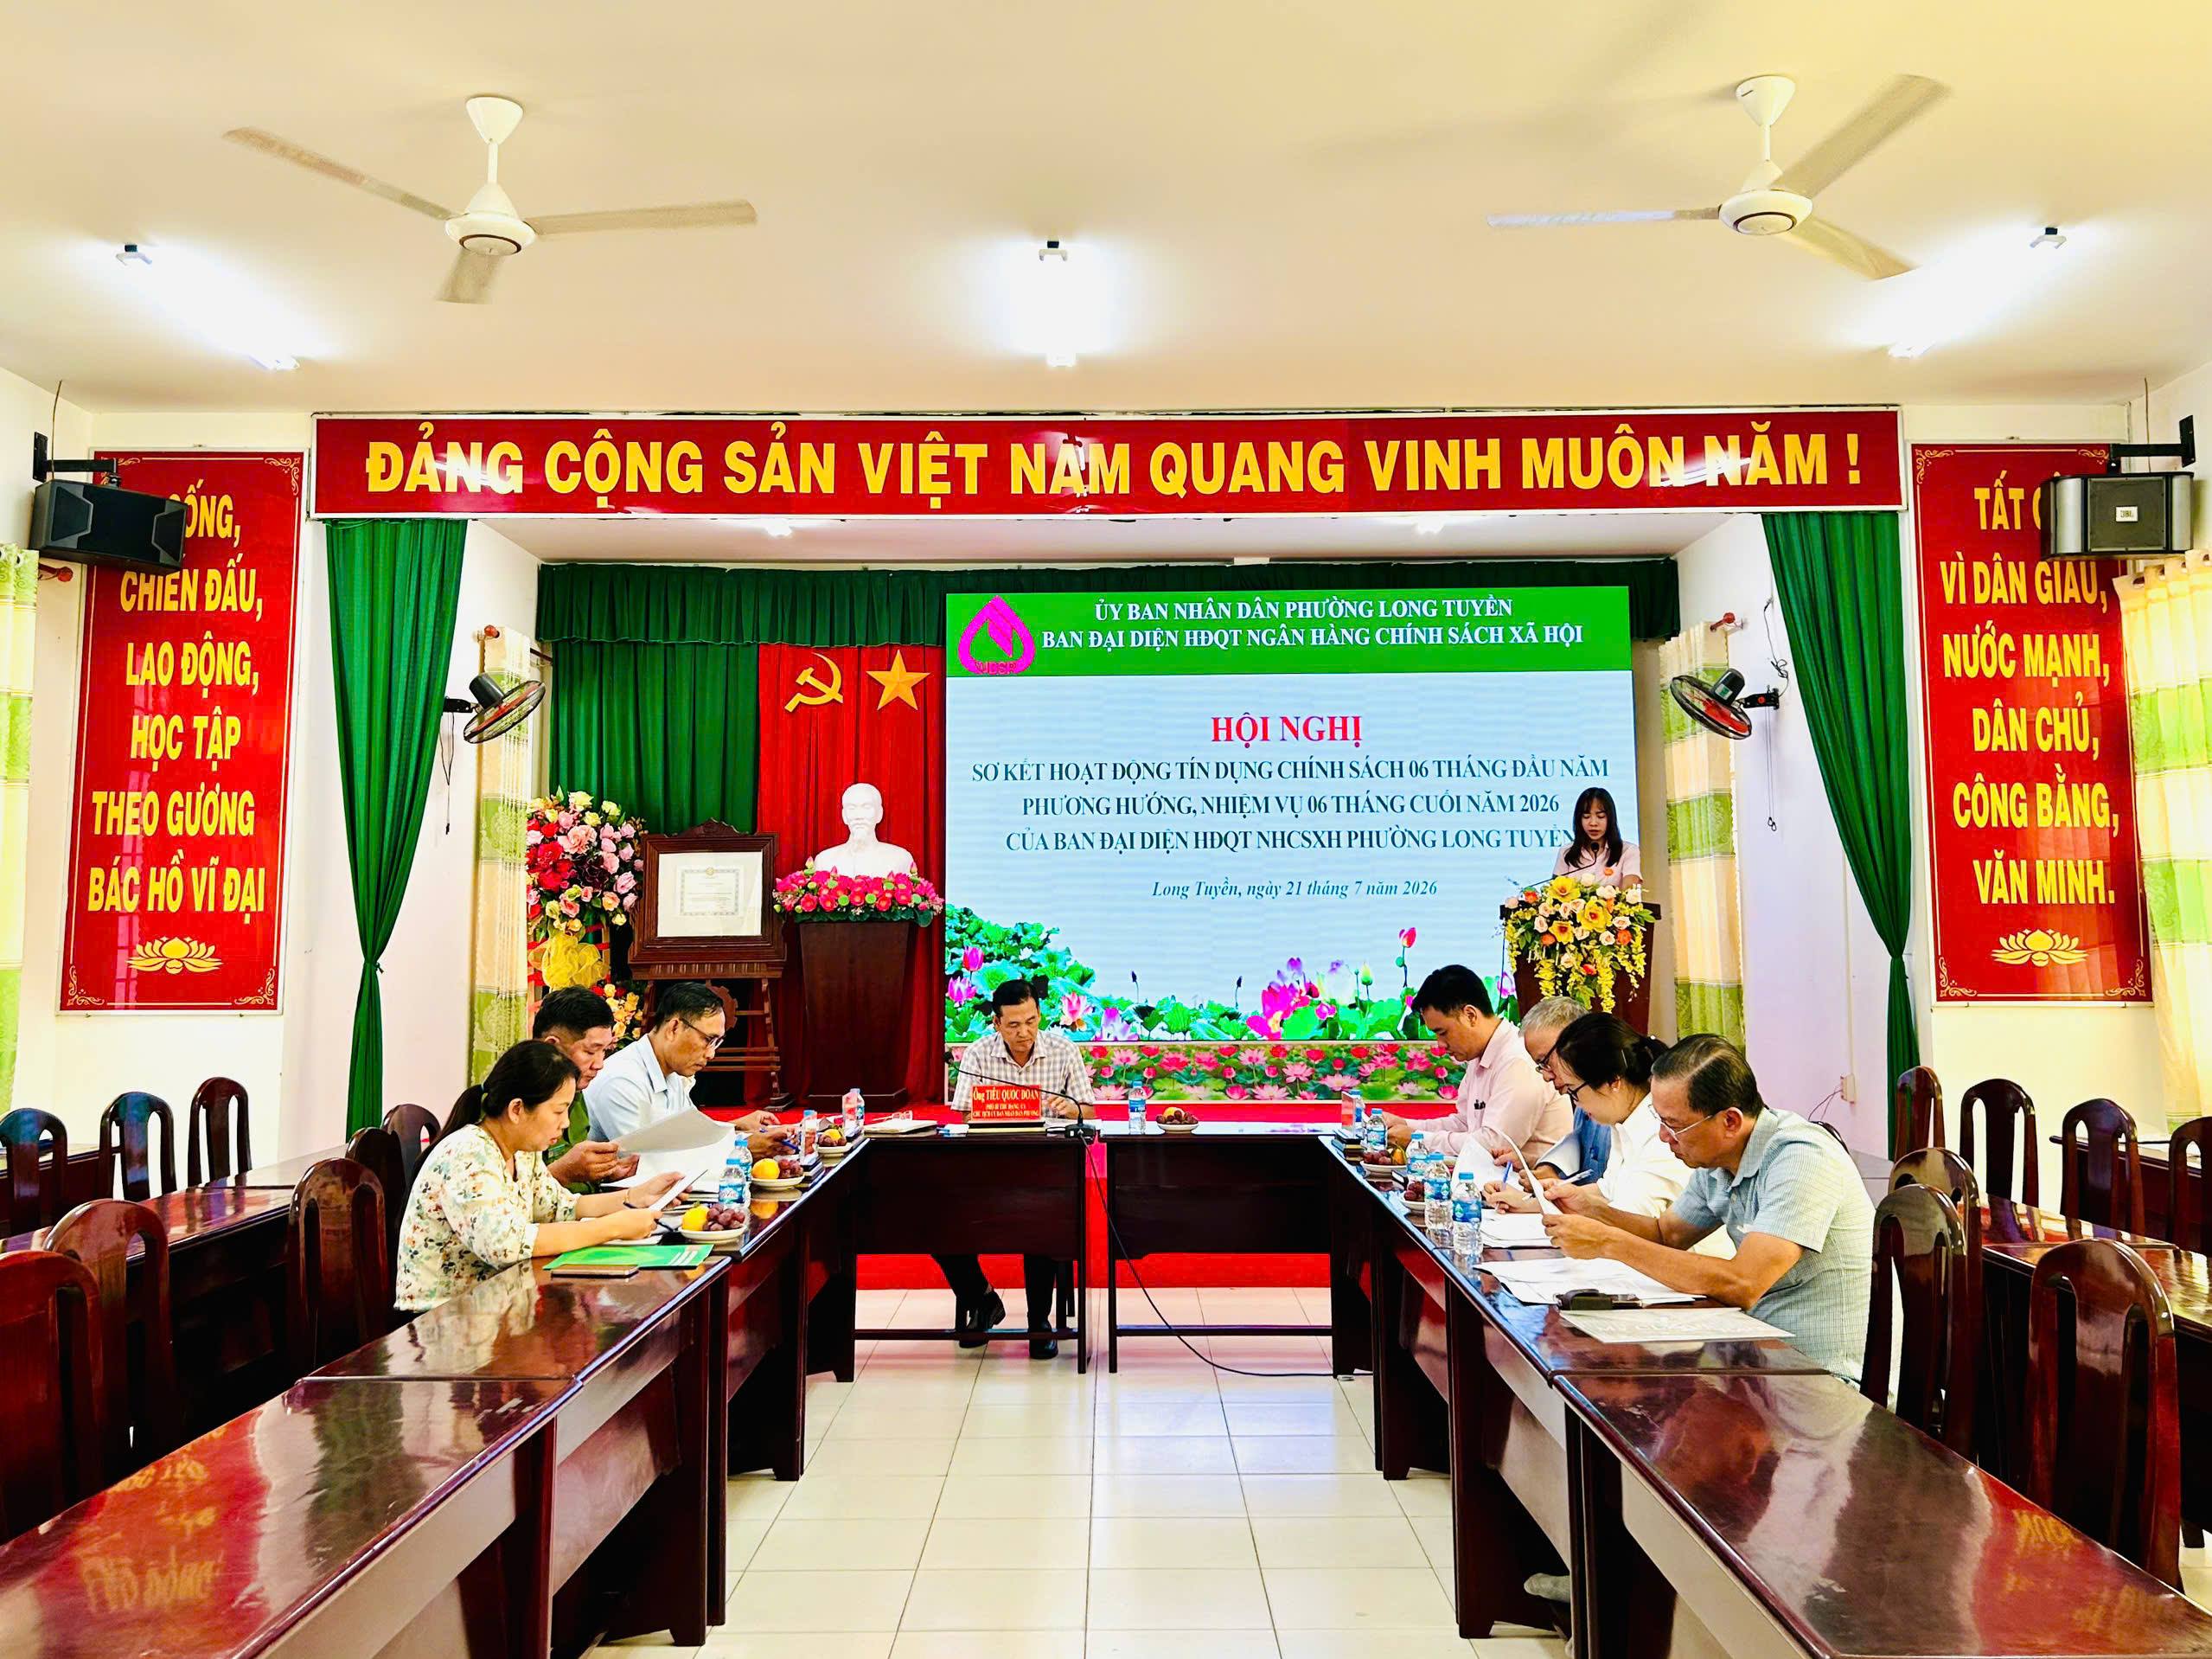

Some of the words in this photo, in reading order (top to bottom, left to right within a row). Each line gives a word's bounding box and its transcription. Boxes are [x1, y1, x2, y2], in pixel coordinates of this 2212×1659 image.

[366, 422, 524, 495] ĐẢNG
[544, 428, 704, 509] CỘNG
[724, 420, 837, 495] SẢN
[858, 432, 988, 509] VIỆT
[1010, 444, 1130, 495] NAM
[1150, 440, 1344, 498] QUANG
[1365, 439, 1500, 490] VINH
[1522, 422, 1685, 490] MUÔN
[1703, 420, 1828, 486] NĂM
[1845, 432, 1861, 485] !
[169, 479, 240, 548] ỐNG,
[1974, 471, 2023, 529] TẤT
[205, 554, 262, 621] ĐẤU,
[1940, 552, 1966, 604] VÌ
[1973, 553, 2027, 604] DÂN
[1096, 599, 1122, 620] ỦY
[1128, 604, 1167, 619] BAN
[1175, 598, 1231, 618] NHÂN
[1238, 597, 1278, 618] DÂN
[1287, 596, 1373, 618] PHƯỜNG
[1380, 600, 1437, 617] LONG
[1442, 594, 1512, 617] TUYỀN
[126, 642, 174, 686] LAO
[181, 631, 259, 698] ĐỘNG,
[1043, 631, 1083, 647] BAN
[1090, 631, 1123, 651] ĐẠI
[1131, 628, 1178, 650] DIỆN
[1186, 630, 1242, 649] HĐQT
[1247, 624, 1304, 645] NGÂN
[1312, 624, 1369, 644] HÀNG
[1376, 623, 1442, 644] CHÍNH
[1449, 623, 1503, 644] SÁCH
[1511, 623, 1538, 643] XÃ
[1544, 624, 1582, 647] HỘI
[1943, 620, 2016, 678] NƯỚC
[2023, 634, 2109, 694] MẠNH,
[131, 714, 183, 771] HỌC
[193, 707, 240, 770] TẬP
[1211, 712, 1270, 748] HỘI
[1280, 716, 1362, 747] NGHỊ
[1972, 698, 2027, 751] DÂN
[2036, 691, 2099, 760] CHỦ,
[973, 762, 1000, 781] SƠ
[1004, 759, 1045, 780] KẾT
[1049, 763, 1108, 785] HOẠT
[1112, 759, 1171, 785] ĐỘNG
[1175, 757, 1210, 779] TÍN
[1215, 761, 1273, 784] DỤNG
[1277, 755, 1345, 779] CHÍNH
[1349, 755, 1404, 778] SÁCH
[1409, 760, 1429, 778] 06
[1432, 754, 1507, 778] THÁNG
[1512, 754, 1555, 778] ĐẦU
[1560, 754, 1608, 777] NĂM
[93, 791, 159, 838] THEO
[167, 782, 254, 836] GƯƠNG
[1024, 795, 1111, 815] PHƯƠNG
[1116, 791, 1197, 817] HƯỚNG,
[1201, 793, 1270, 818] NHIỆM
[1275, 796, 1303, 818] VỤ
[1307, 796, 1327, 813] 06
[1331, 790, 1405, 813] THÁNG
[1410, 790, 1462, 813] CUỐI
[1467, 791, 1515, 812] NĂM
[1519, 794, 1559, 811] 2026
[1953, 773, 2028, 828] CÔNG
[2035, 764, 2119, 840] BẰNG,
[1007, 827, 1049, 850] CỦA
[1054, 832, 1096, 849] BAN
[1100, 832, 1135, 855] ĐẠI
[1140, 829, 1189, 854] DIỆN
[1193, 830, 1252, 852] HĐQT
[1256, 830, 1342, 849] NHCSXH
[1346, 824, 1436, 849] PHƯỜNG
[1442, 830, 1501, 848] LONG
[88, 856, 139, 913] BÁC
[148, 849, 183, 912] HỒ
[191, 856, 219, 911] VĨ
[223, 868, 265, 924] ĐẠI
[1152, 882, 1190, 900] Long
[1196, 877, 1241, 900] Tuyền,
[1247, 882, 1282, 900] ngày
[1286, 881, 1301, 895] 21
[1307, 881, 1349, 900] tháng
[1355, 881, 1363, 894] 7
[1366, 881, 1397, 895] năm
[1403, 881, 1437, 894] 2026
[1973, 849, 2028, 904] VĂN
[2036, 857, 2114, 904] MINH.
